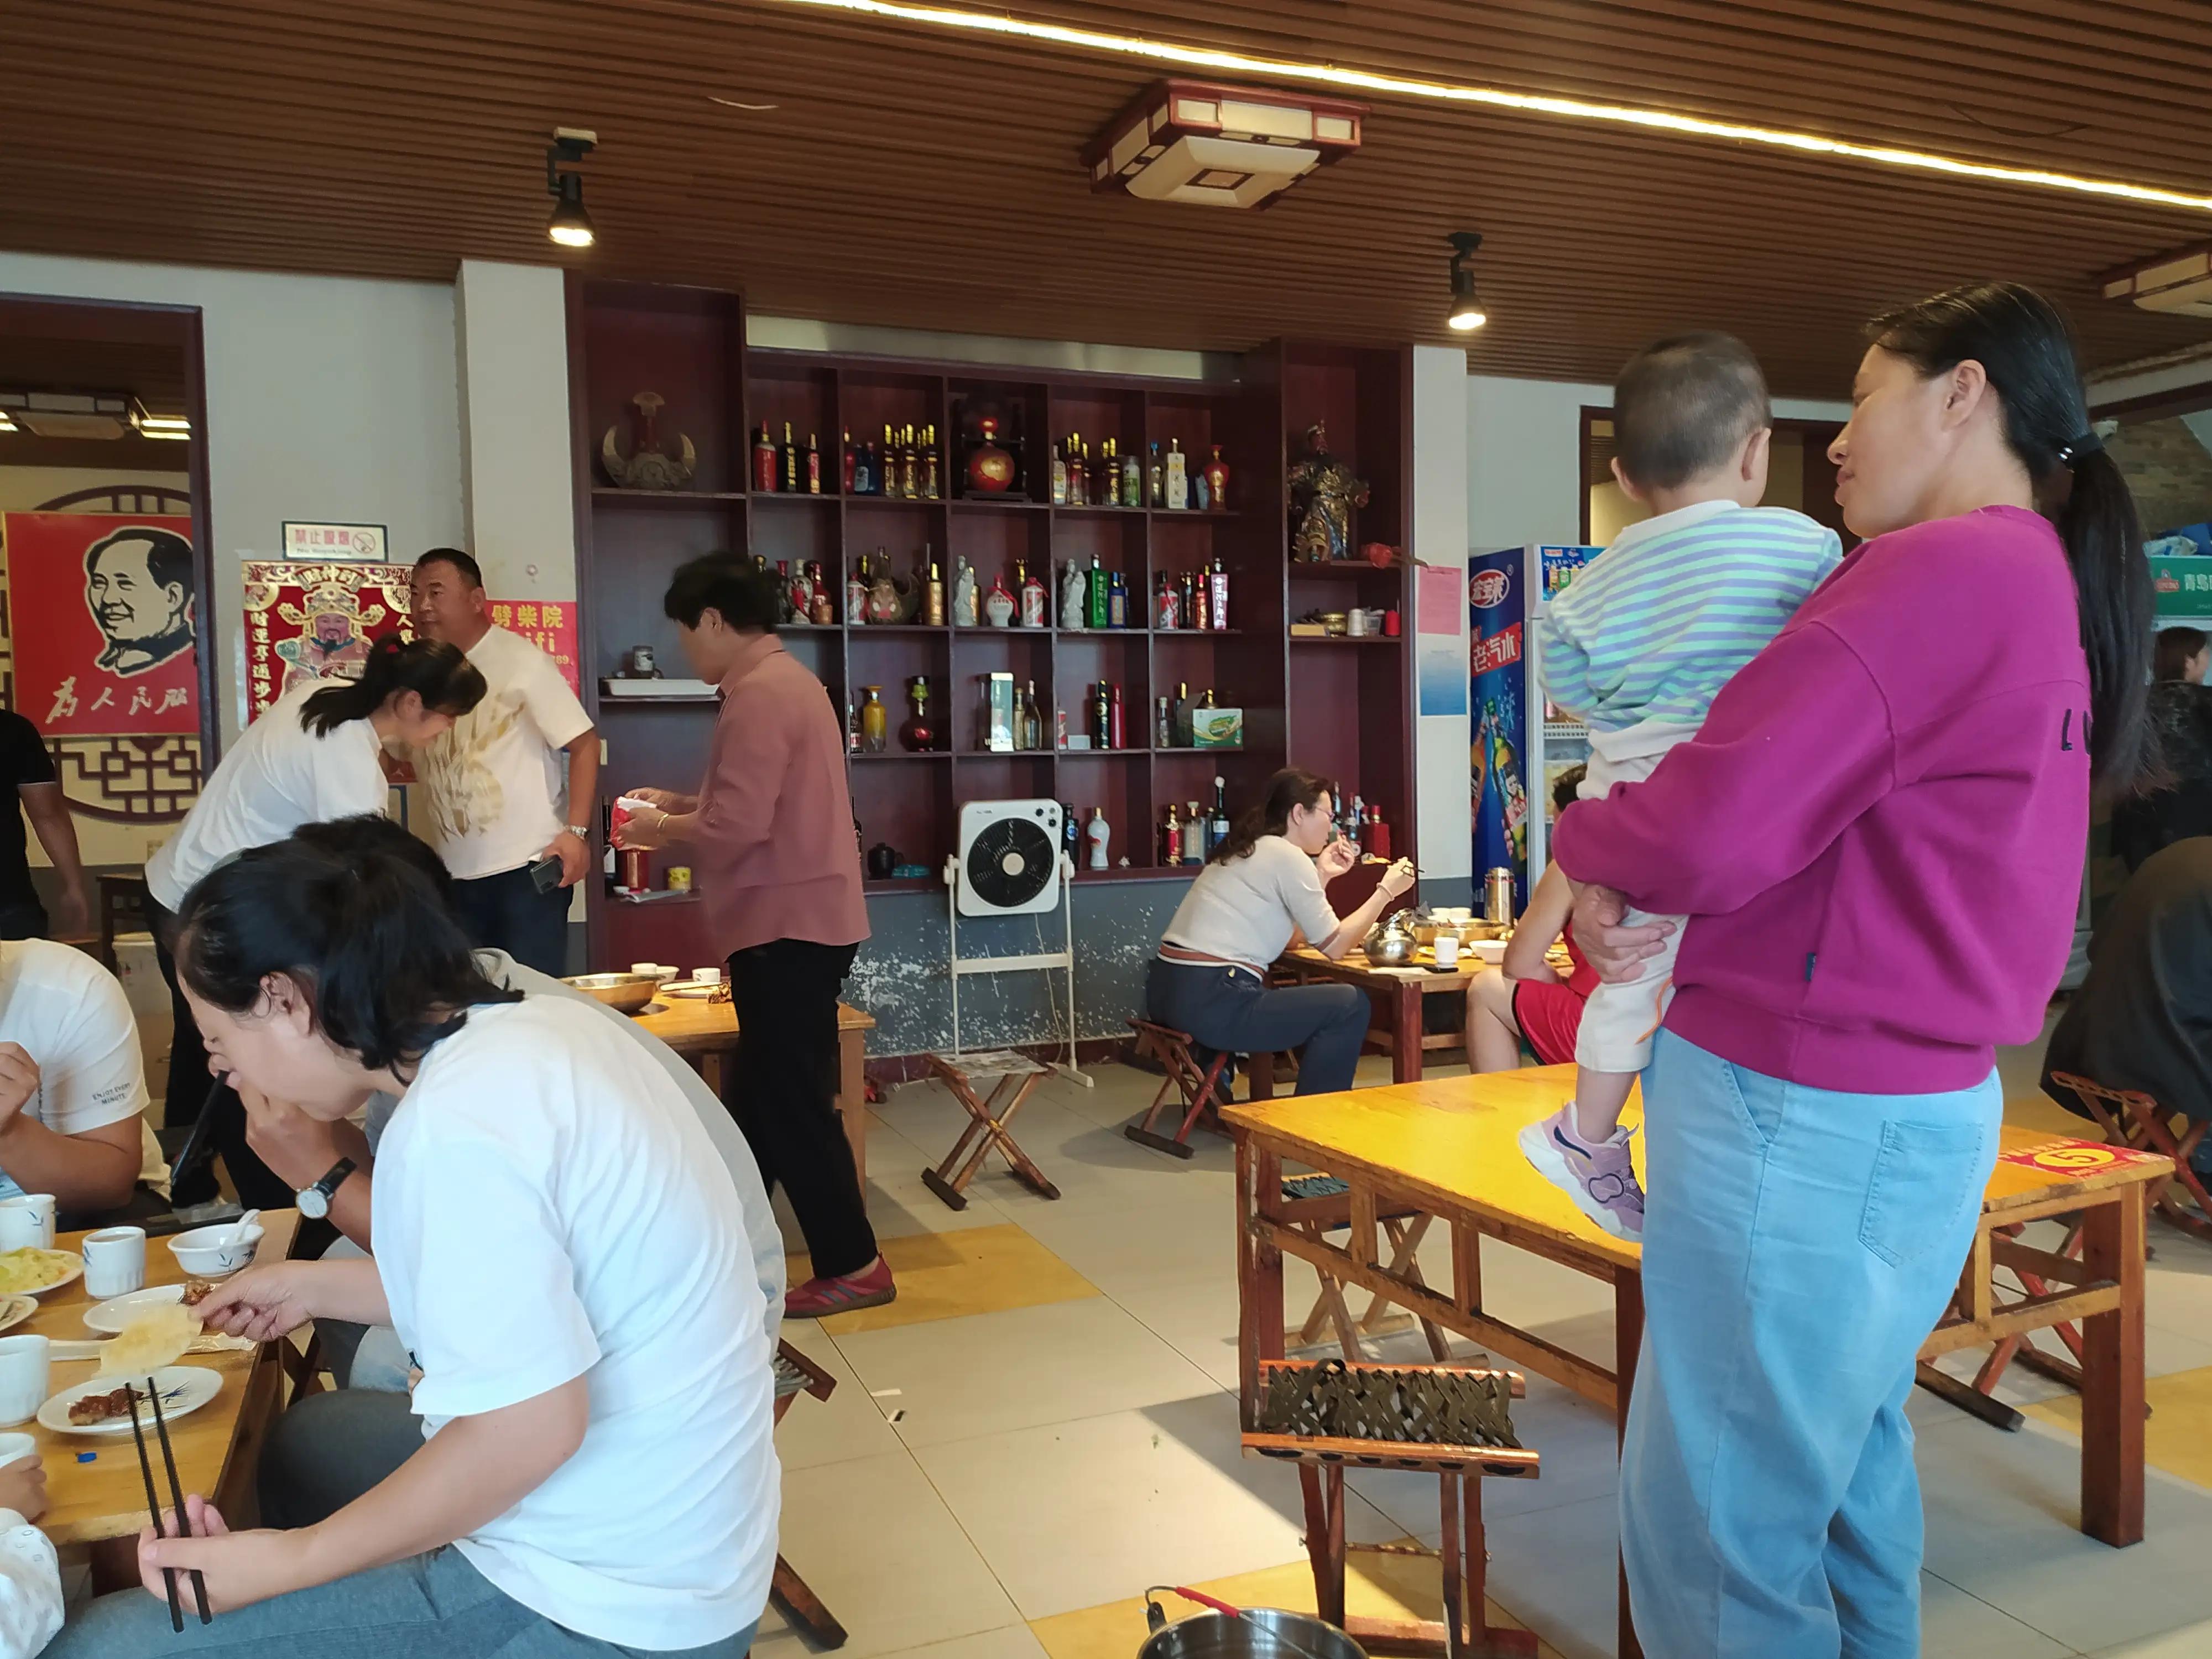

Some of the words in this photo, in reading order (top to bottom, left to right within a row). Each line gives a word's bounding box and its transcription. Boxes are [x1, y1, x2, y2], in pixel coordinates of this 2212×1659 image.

[2184, 573, 2212, 591] 青岛
[492, 604, 564, 628] 劈柴院
[1473, 632, 1516, 673] 老汽水
[2046, 1151, 2100, 1164] 5
